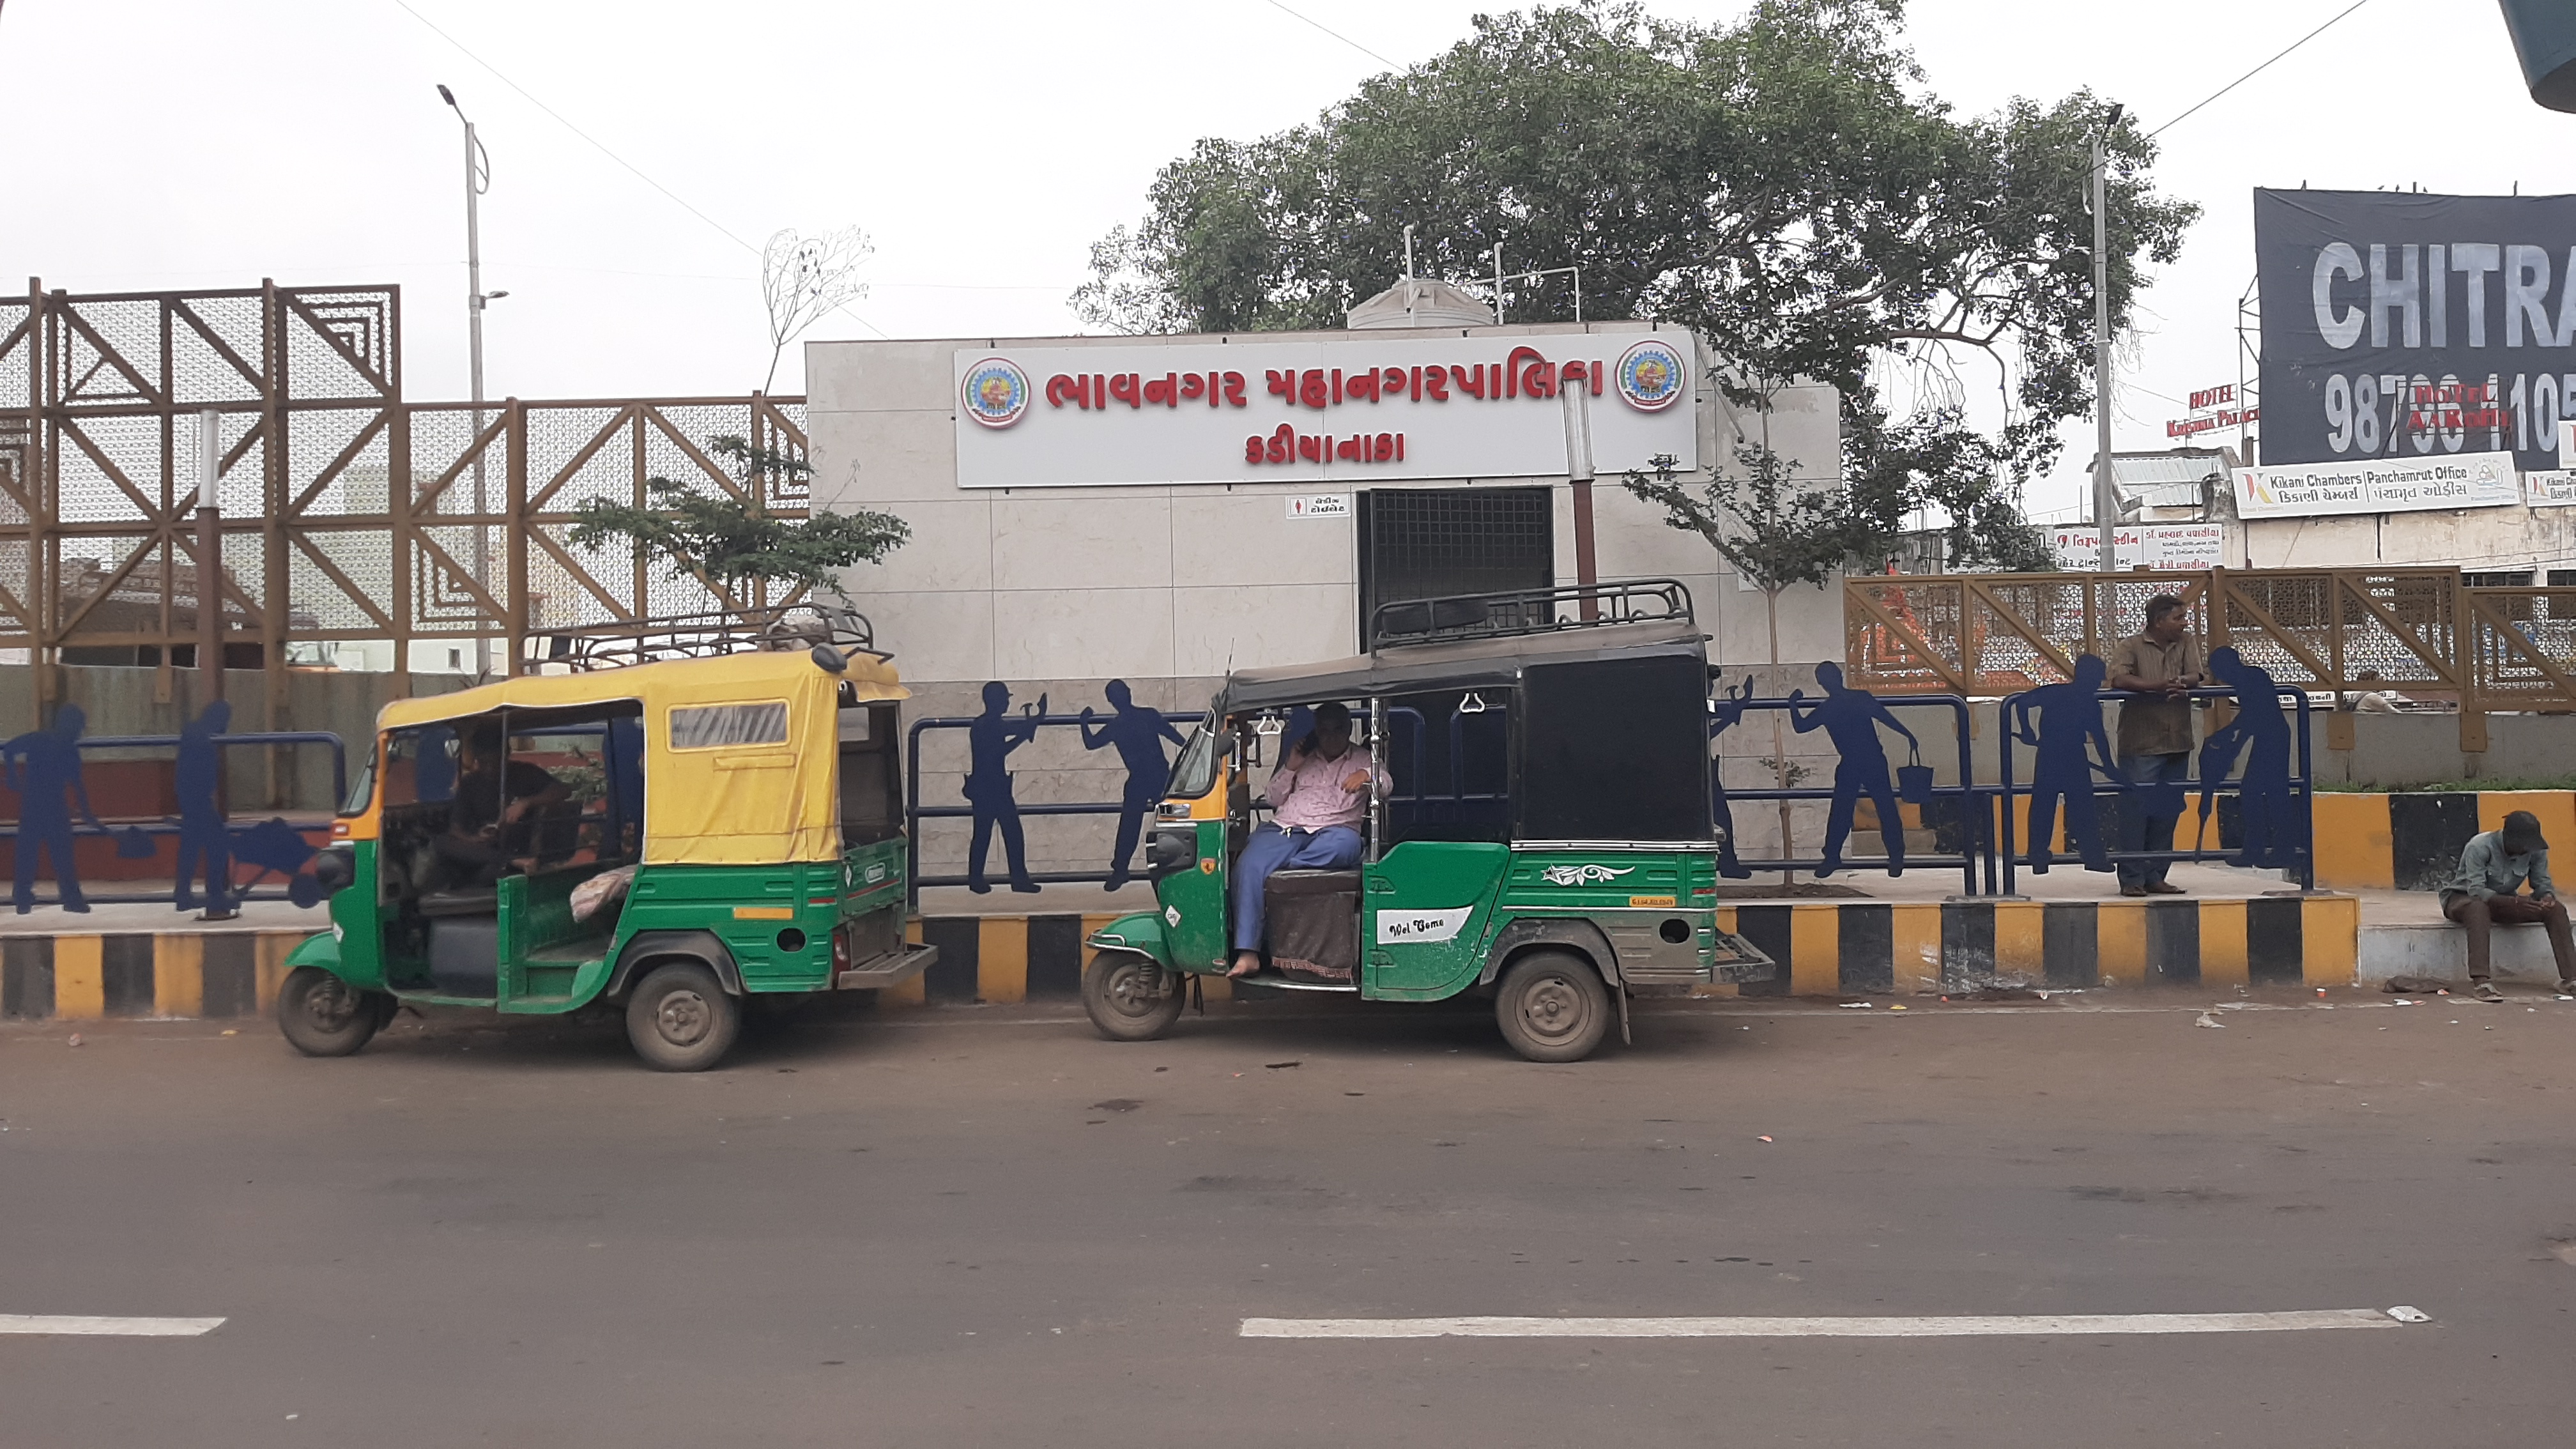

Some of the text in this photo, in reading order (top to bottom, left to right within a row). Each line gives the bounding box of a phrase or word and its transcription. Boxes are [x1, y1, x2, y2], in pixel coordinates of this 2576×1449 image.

[1046, 346, 1603, 410] ભાવનગર મહાનગરપાલિકા
[2189, 385, 2234, 409] HOTEL
[2416, 384, 2496, 404] HOTEL
[2270, 473, 2362, 489] Kikani Chambers
[2367, 466, 2467, 484] Panchamrut Office
